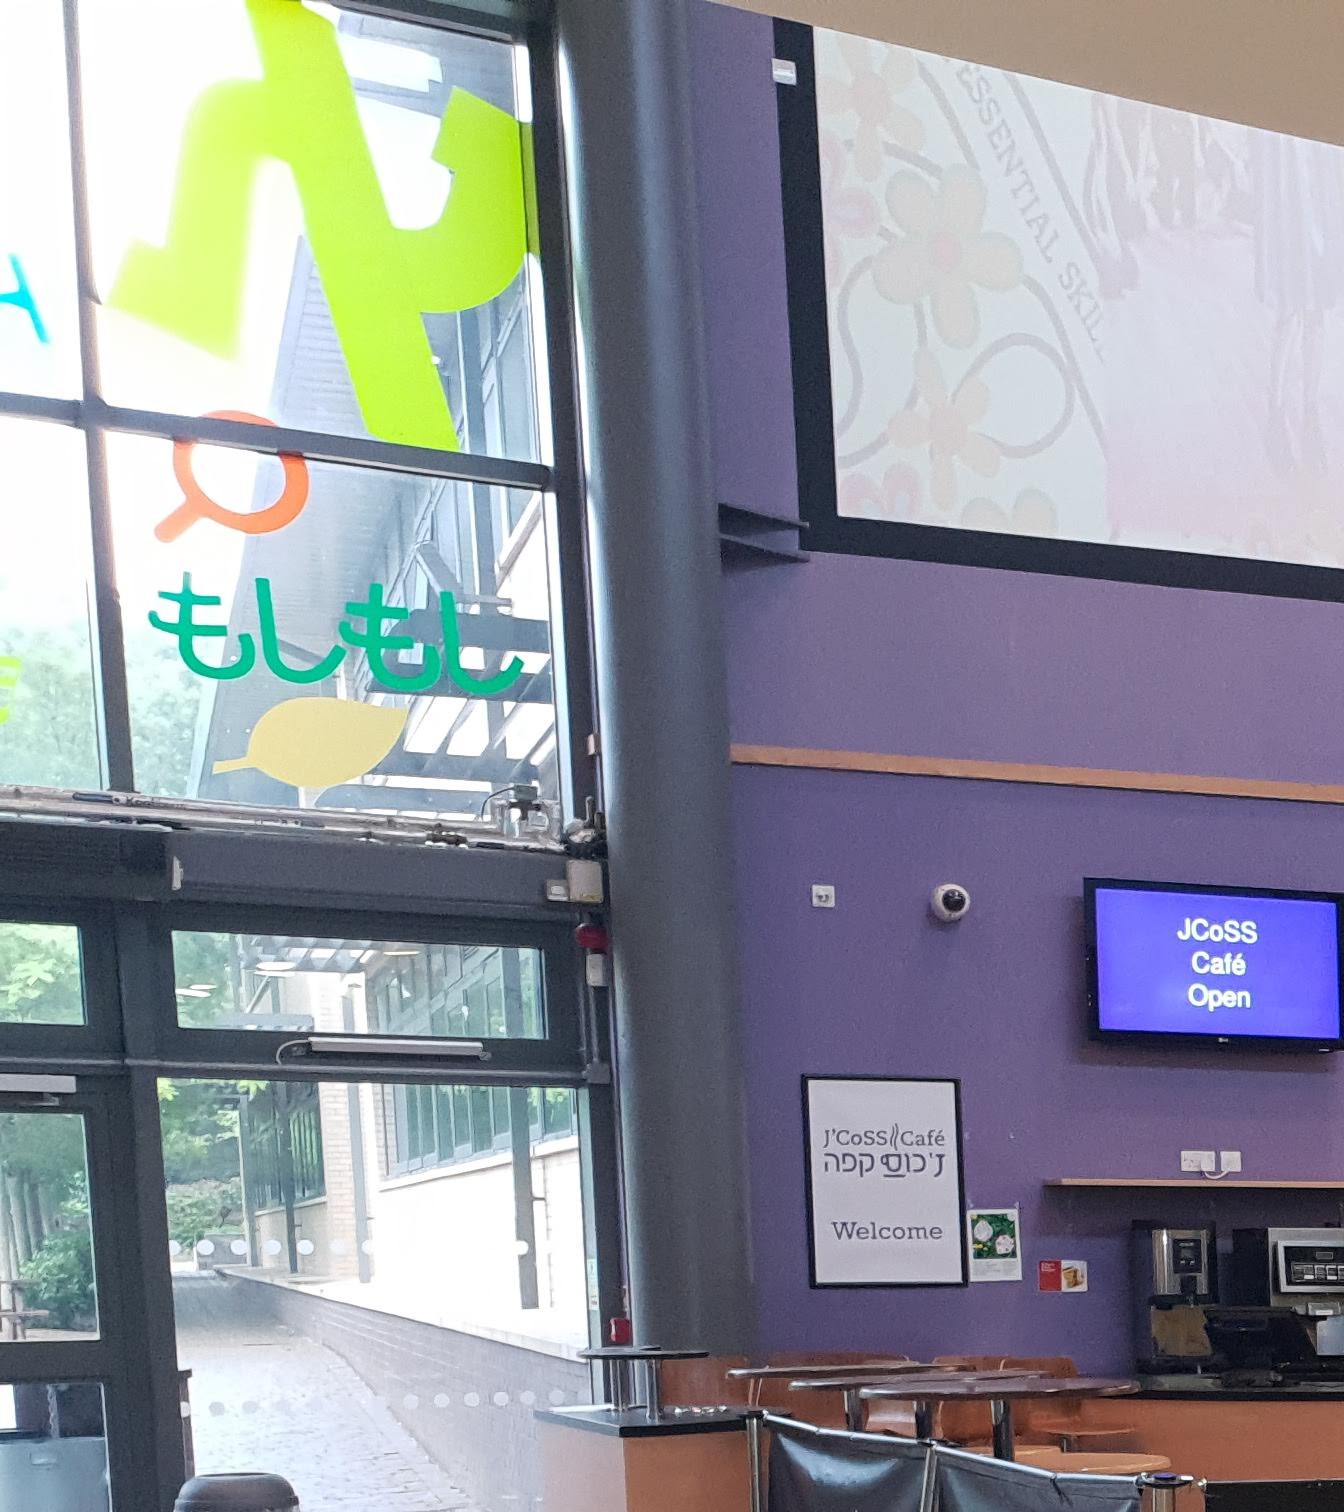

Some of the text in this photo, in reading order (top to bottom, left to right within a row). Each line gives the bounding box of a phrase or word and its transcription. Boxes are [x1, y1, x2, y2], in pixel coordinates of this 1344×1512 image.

[147, 571, 525, 696] もしもし
[1177, 917, 1258, 944] JCoSS
[1191, 951, 1247, 976] Café
[1187, 983, 1251, 1012] Open
[824, 1128, 945, 1149] J'CoSS Café
[824, 1152, 875, 1178] קפה
[831, 1221, 944, 1241] Welcome
